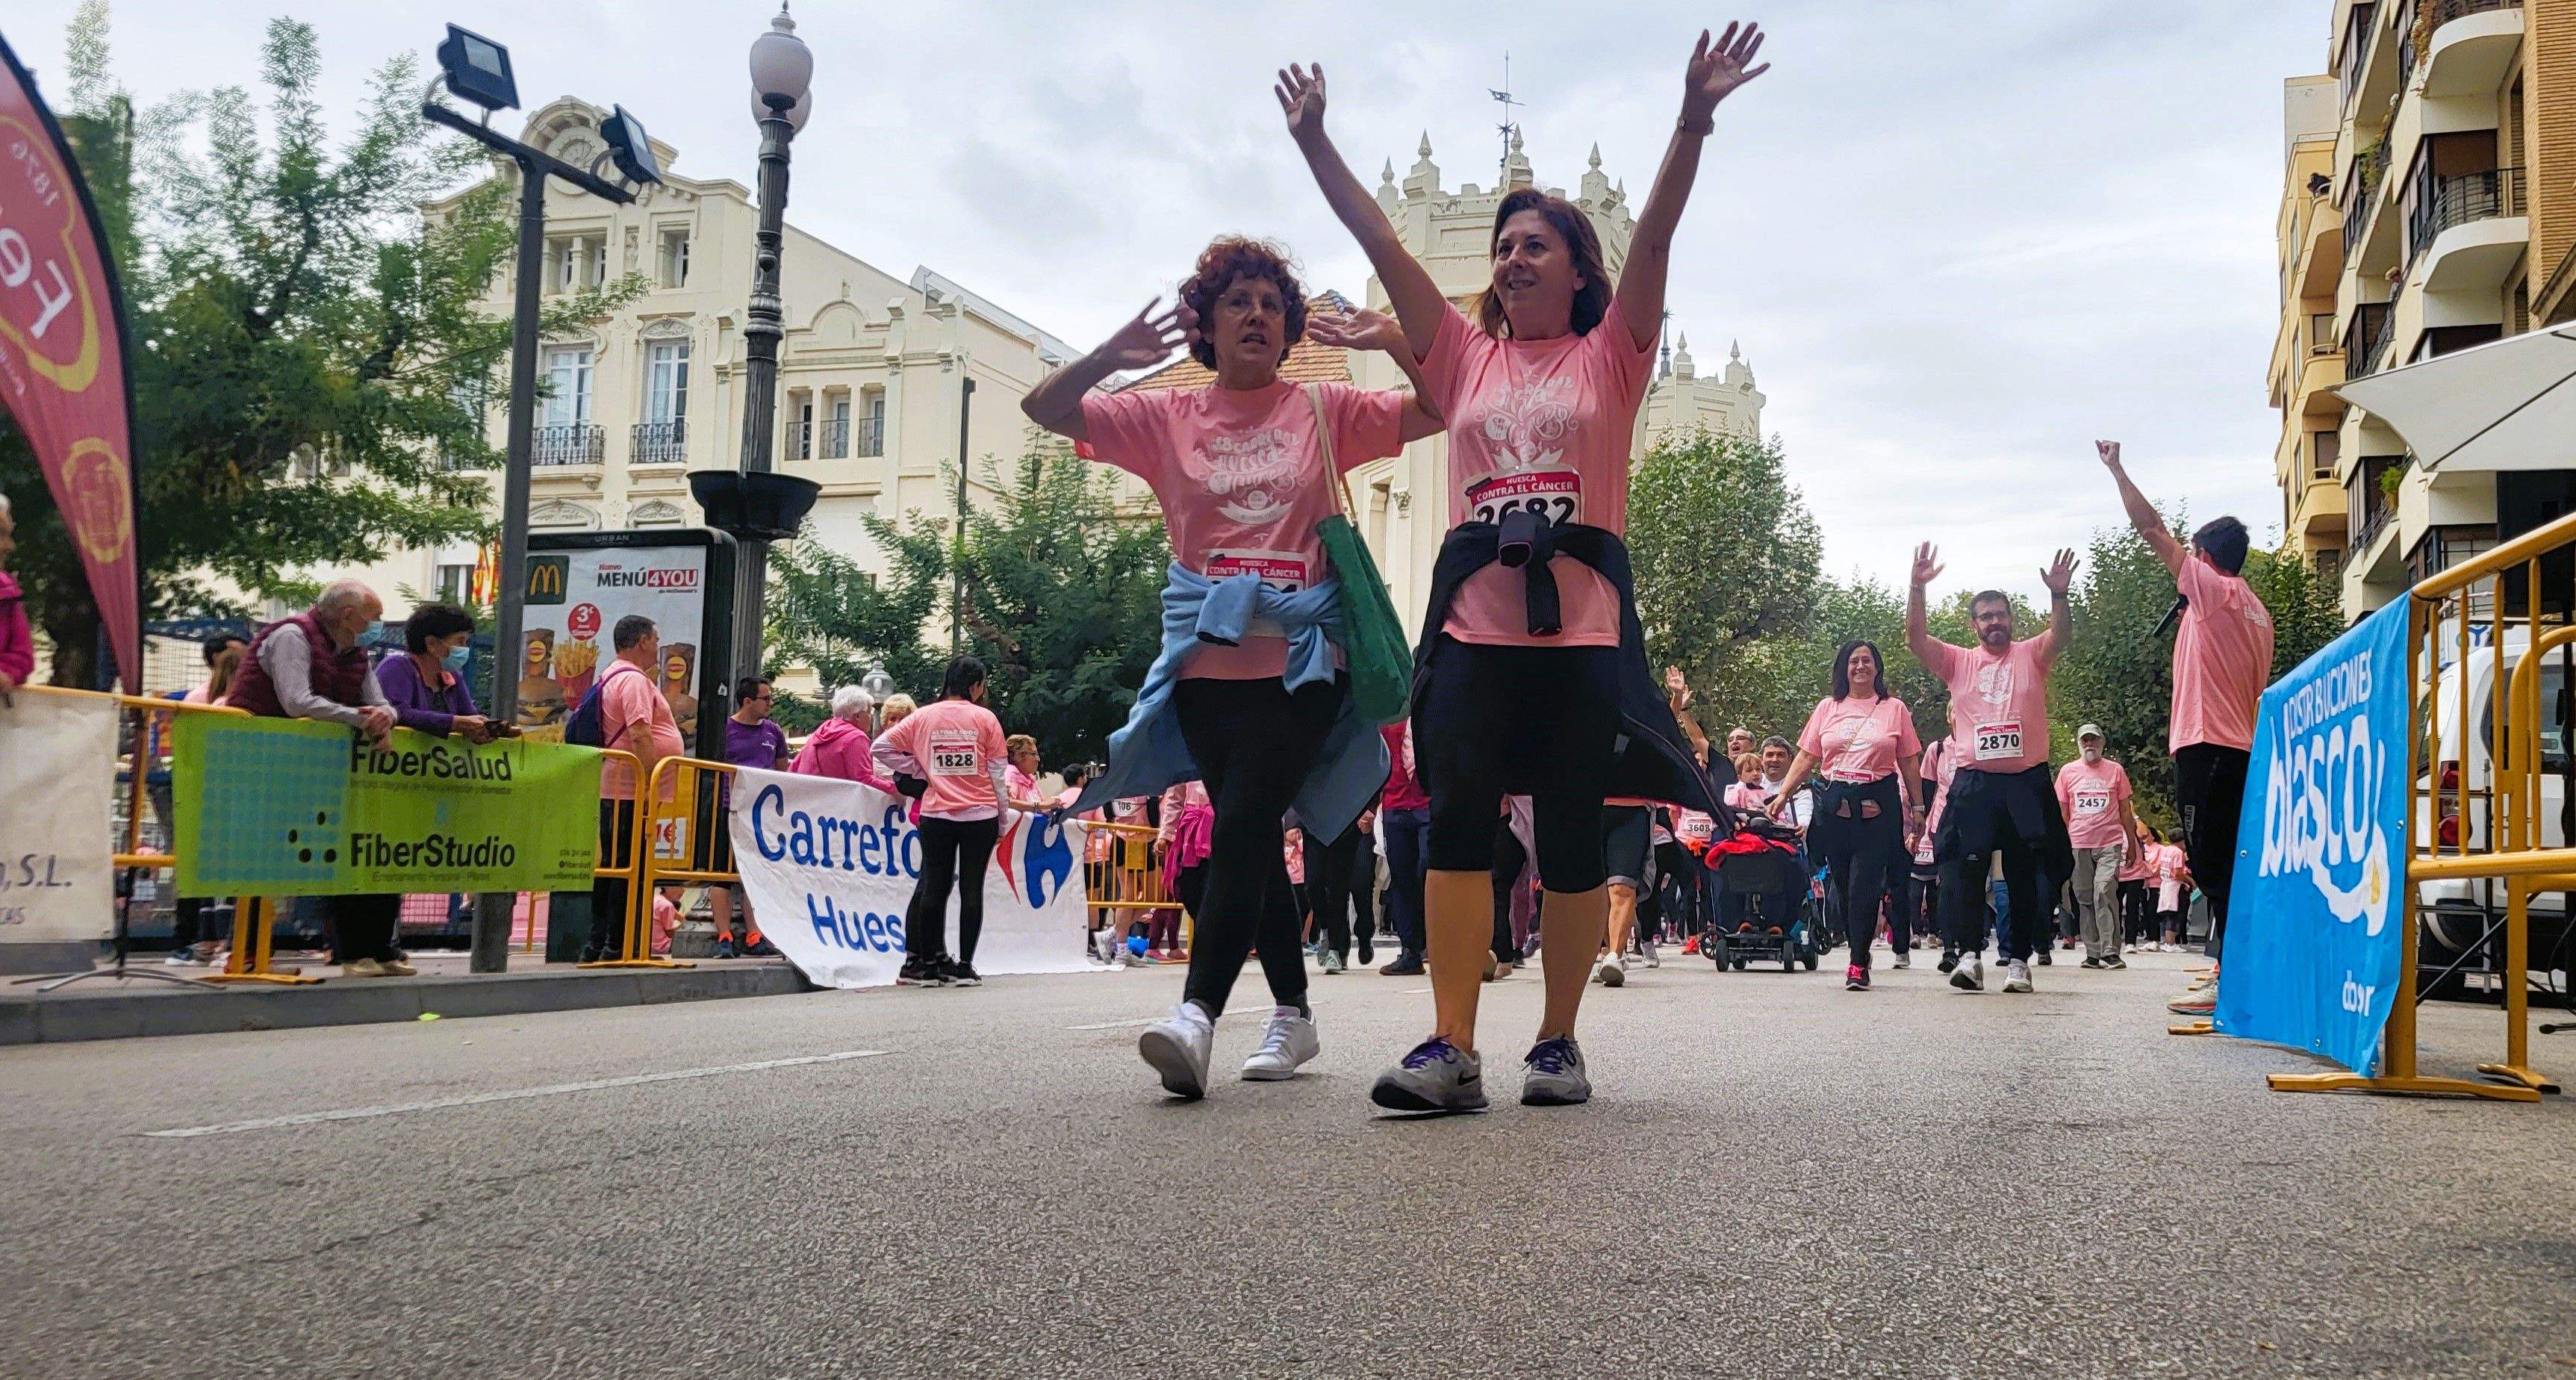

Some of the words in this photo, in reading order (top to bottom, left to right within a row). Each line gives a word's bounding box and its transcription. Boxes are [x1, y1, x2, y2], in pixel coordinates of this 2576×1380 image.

[1507, 475, 1537, 485] HUESCA
[1476, 485, 1515, 502] CONTRA
[1516, 484, 1529, 493] EL
[1531, 481, 1574, 492] CÁNCER
[597, 567, 647, 587] MENÚ
[648, 570, 697, 587] 4YOU
[1263, 568, 1301, 578] CÁNCER
[1979, 733, 2020, 750] 2870
[351, 739, 512, 781] FiberSalud
[936, 753, 974, 767] 1828
[2258, 703, 2372, 879] blasco
[2078, 798, 2106, 807] 2457
[752, 783, 923, 880] Carrefo
[350, 833, 515, 868] FiberStudio
[18, 854, 73, 886] S.L.
[806, 892, 906, 954] Hues
